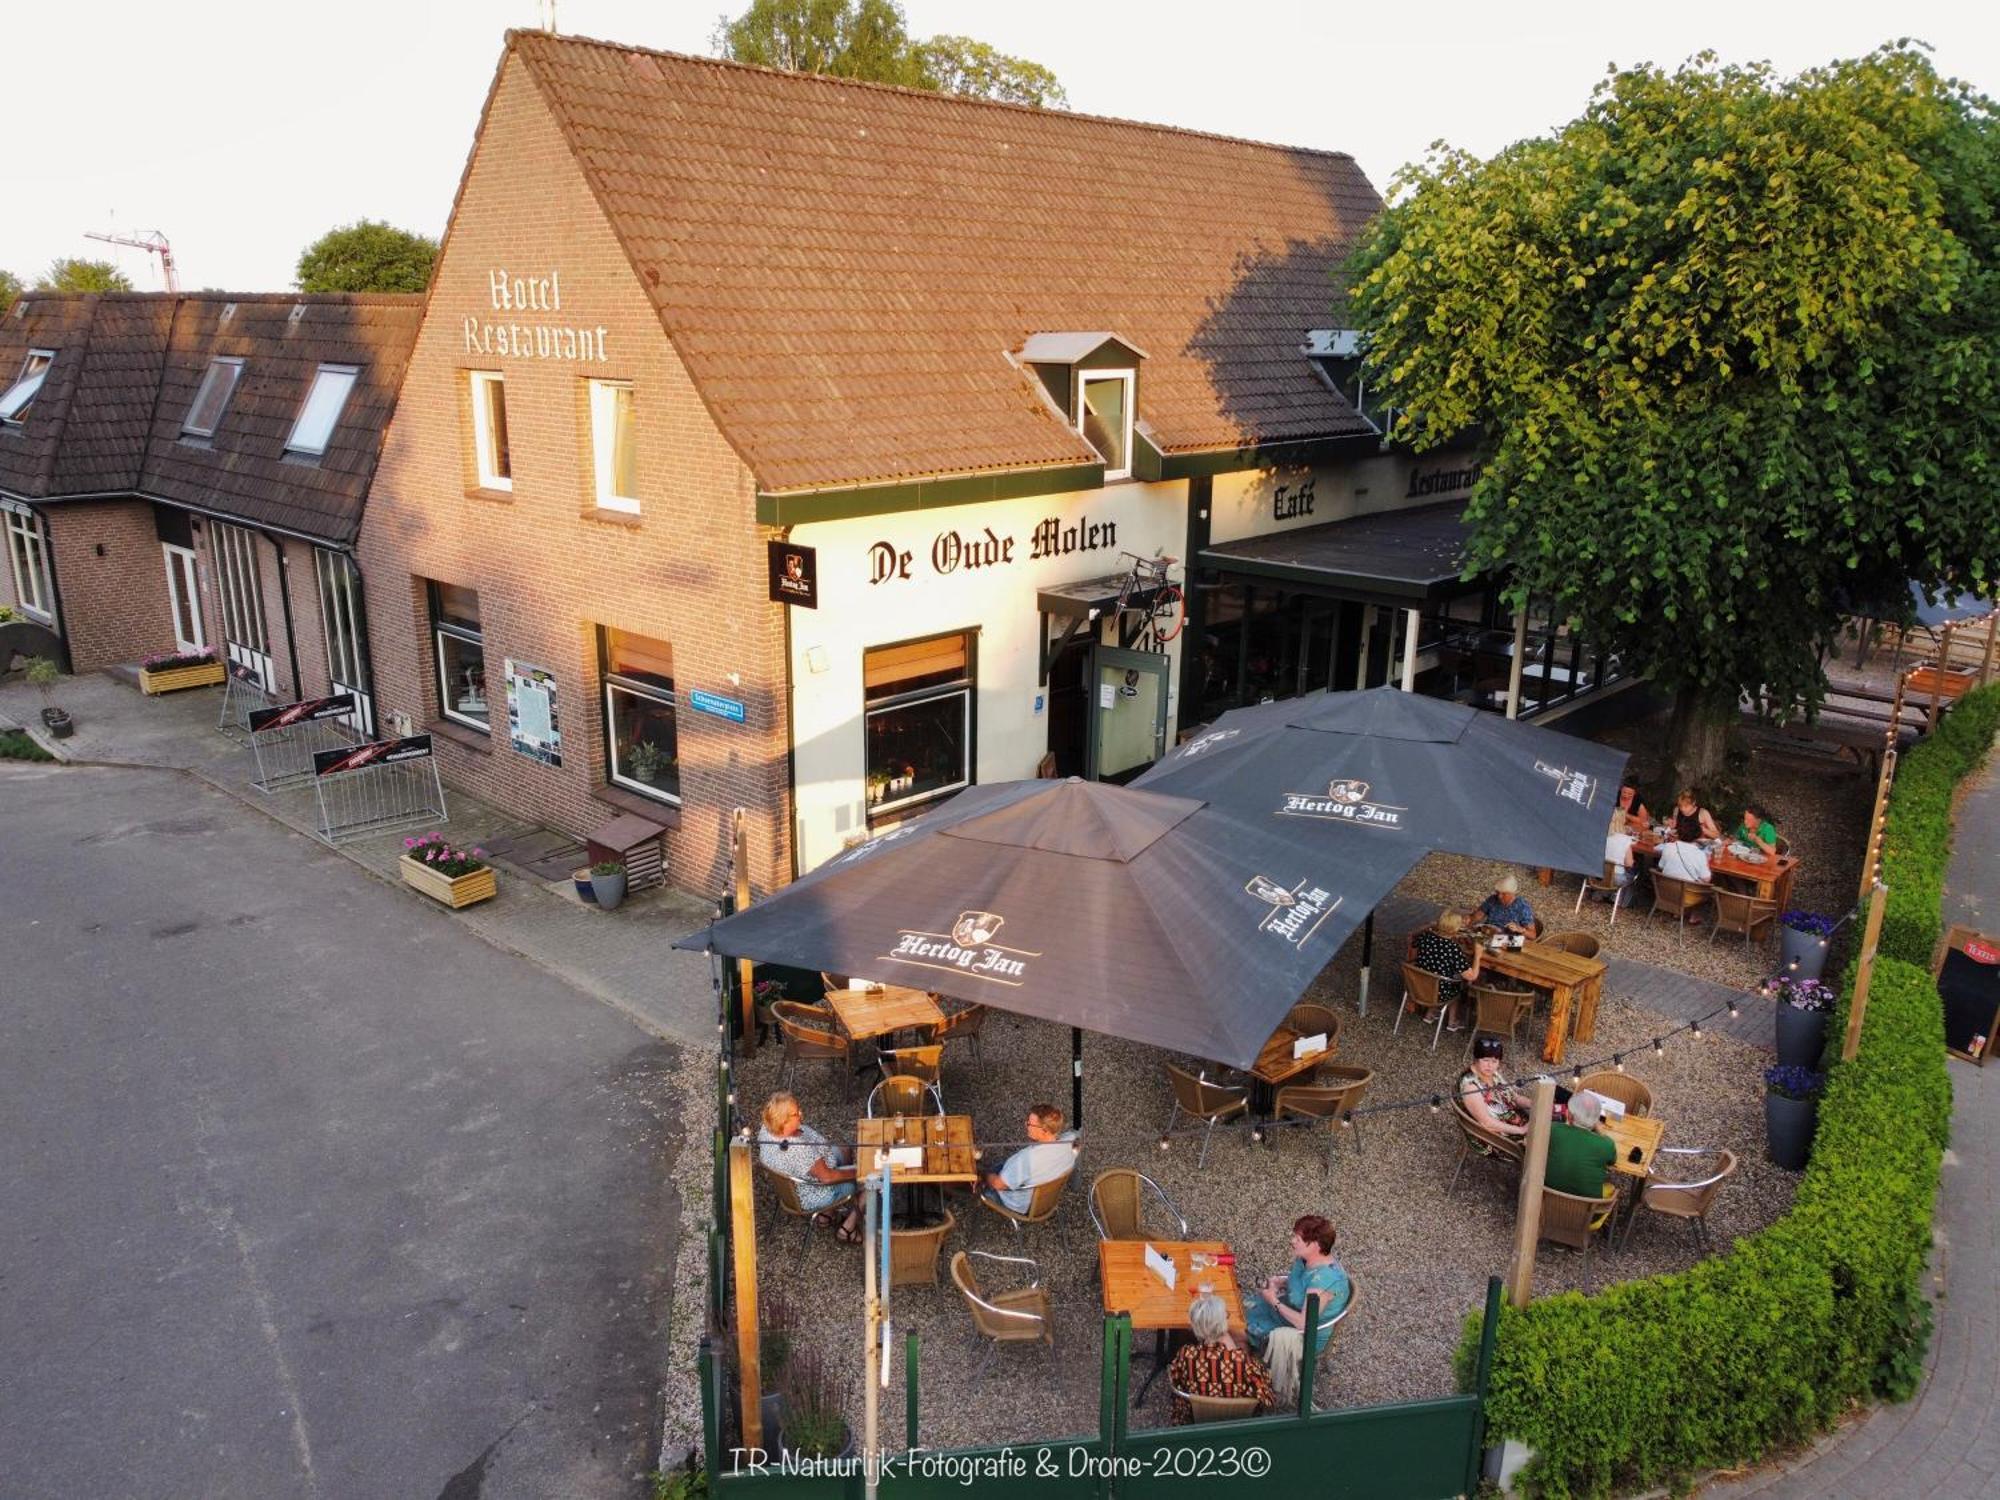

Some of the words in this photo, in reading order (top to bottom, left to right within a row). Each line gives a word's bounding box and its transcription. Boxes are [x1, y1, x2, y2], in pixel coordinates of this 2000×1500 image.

[489, 268, 561, 311] Hotel
[460, 313, 609, 362] Restaurant
[1273, 478, 1316, 521] Café
[1405, 466, 1482, 498] Restauran
[867, 540, 913, 585] De
[931, 527, 1015, 575] Oude
[1029, 516, 1117, 560] Molen
[1283, 796, 1357, 818] Hertog
[1355, 804, 1399, 824] Jan
[1267, 900, 1320, 942] Hertog
[1298, 887, 1331, 911] Jan
[890, 934, 977, 967] Hertog
[971, 948, 1026, 976] Jan
